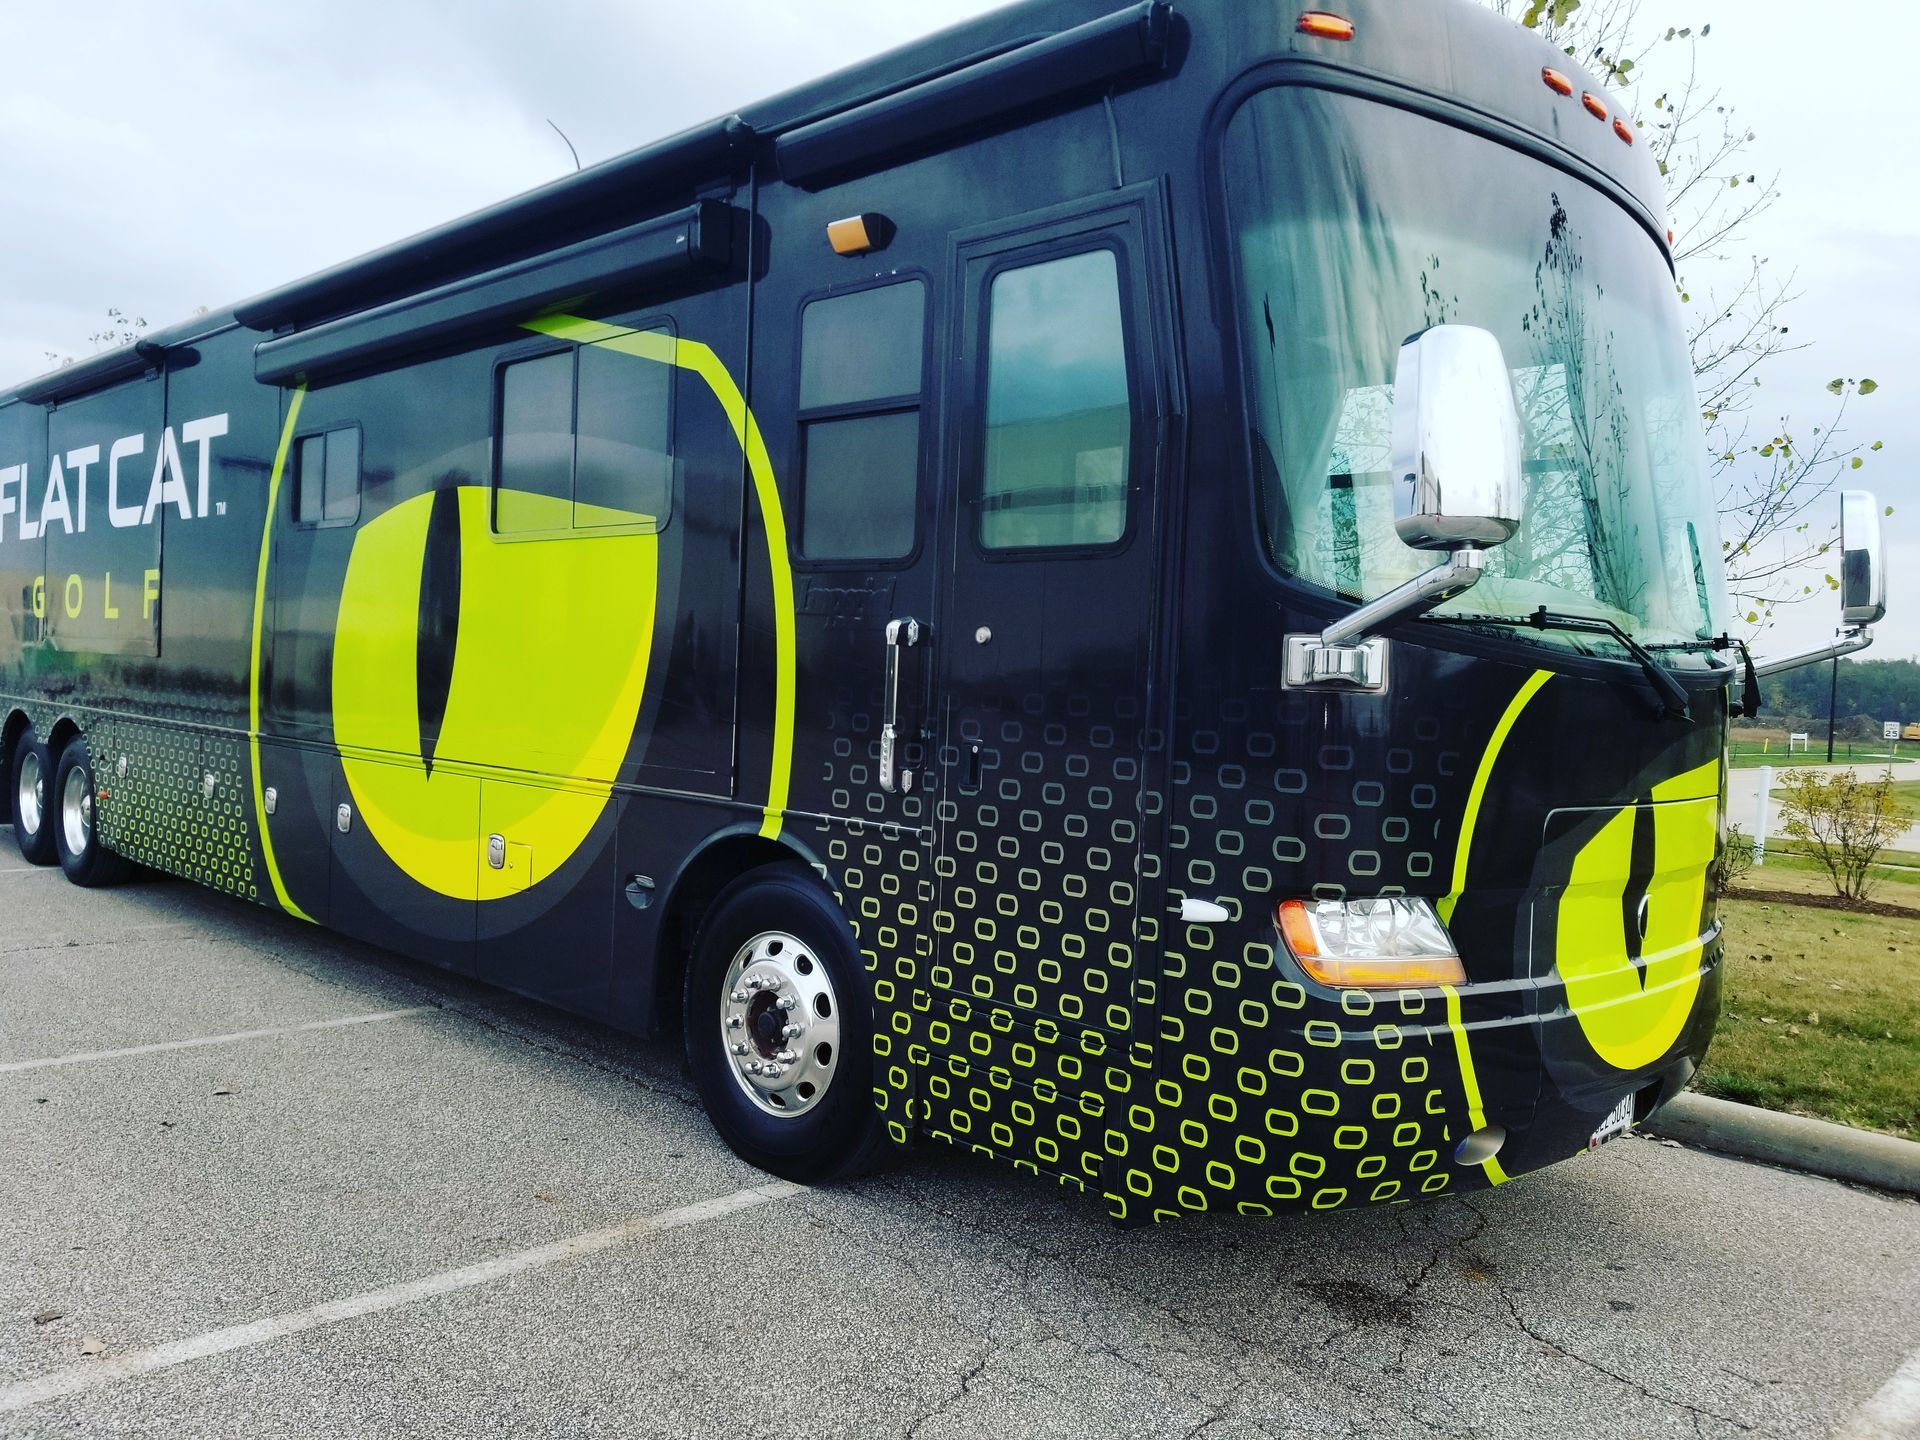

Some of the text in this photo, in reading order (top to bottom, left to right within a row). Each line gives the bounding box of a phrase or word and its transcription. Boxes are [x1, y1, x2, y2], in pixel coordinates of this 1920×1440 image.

[0, 444, 100, 543] FLAT
[108, 413, 229, 528] CAT
[32, 568, 160, 619] GOLF
